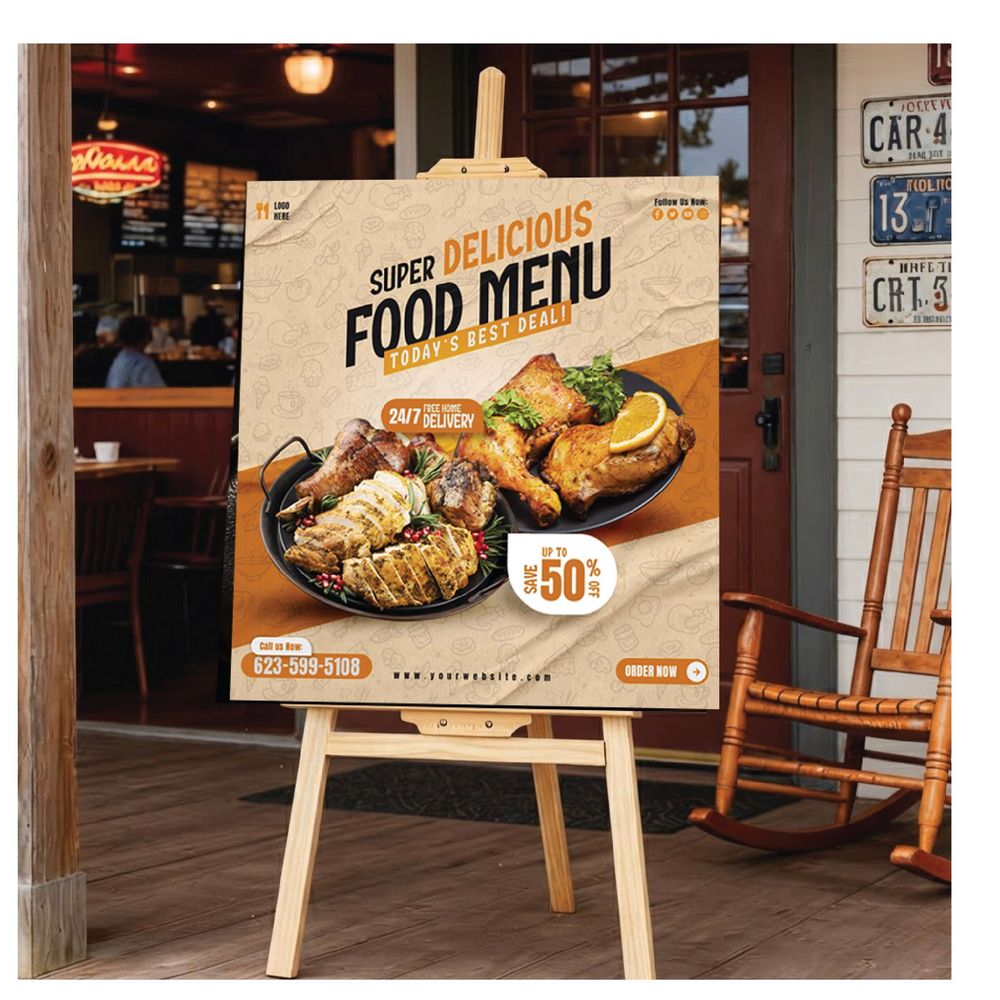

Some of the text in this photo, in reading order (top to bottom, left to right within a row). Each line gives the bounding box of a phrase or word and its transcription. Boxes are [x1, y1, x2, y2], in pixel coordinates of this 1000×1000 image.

[274, 201, 290, 210] LOGO
[654, 198, 709, 206] Follow Us Now:
[274, 212, 290, 220] HERE
[370, 199, 592, 295] SUPER DELICIOUS
[345, 236, 611, 368] FOOD MENU
[390, 304, 566, 369] TODAY'S BEST DEAL!
[389, 403, 462, 425] 24/7 FREE HOME
[423, 413, 474, 429] DELIVERY
[541, 547, 568, 558] UP TO
[524, 564, 538, 594] SAVE
[588, 580, 600, 598] OFF
[259, 641, 303, 651] Call us Now:
[254, 656, 361, 676] 623-599-5108
[624, 665, 677, 678] ORDER NOW
[393, 670, 552, 682] www.yourwebsite.com
